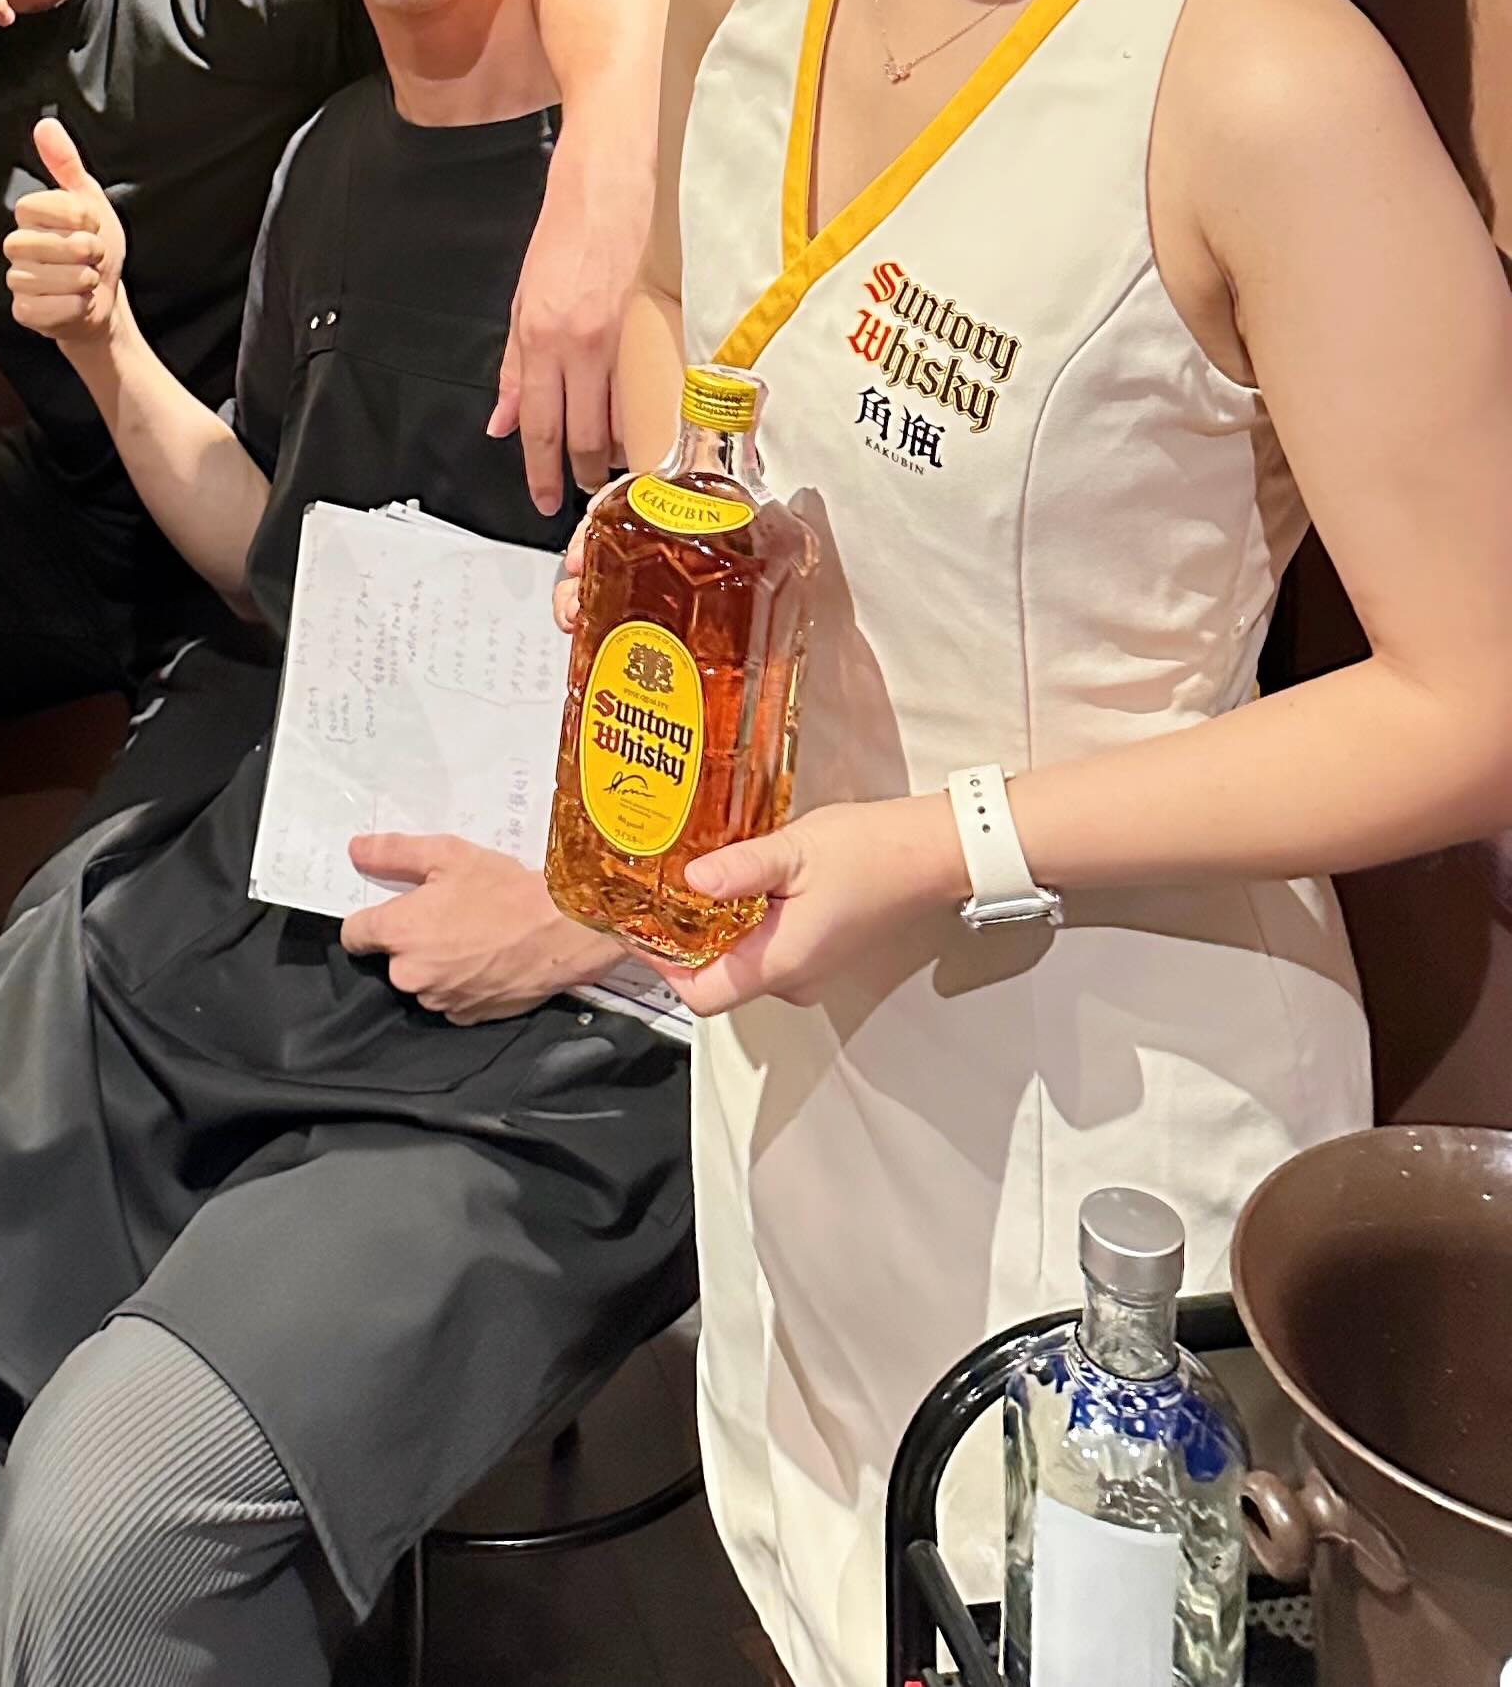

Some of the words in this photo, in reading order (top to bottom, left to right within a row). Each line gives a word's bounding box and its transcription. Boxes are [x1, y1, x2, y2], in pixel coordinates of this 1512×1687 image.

[863, 262, 1022, 384] Suntory
[846, 308, 1000, 434] Whisky
[864, 435, 925, 476] KAKUBIN
[638, 489, 721, 523] KAKUBIN
[592, 689, 694, 756] Suntory
[592, 720, 686, 786] Whisky
